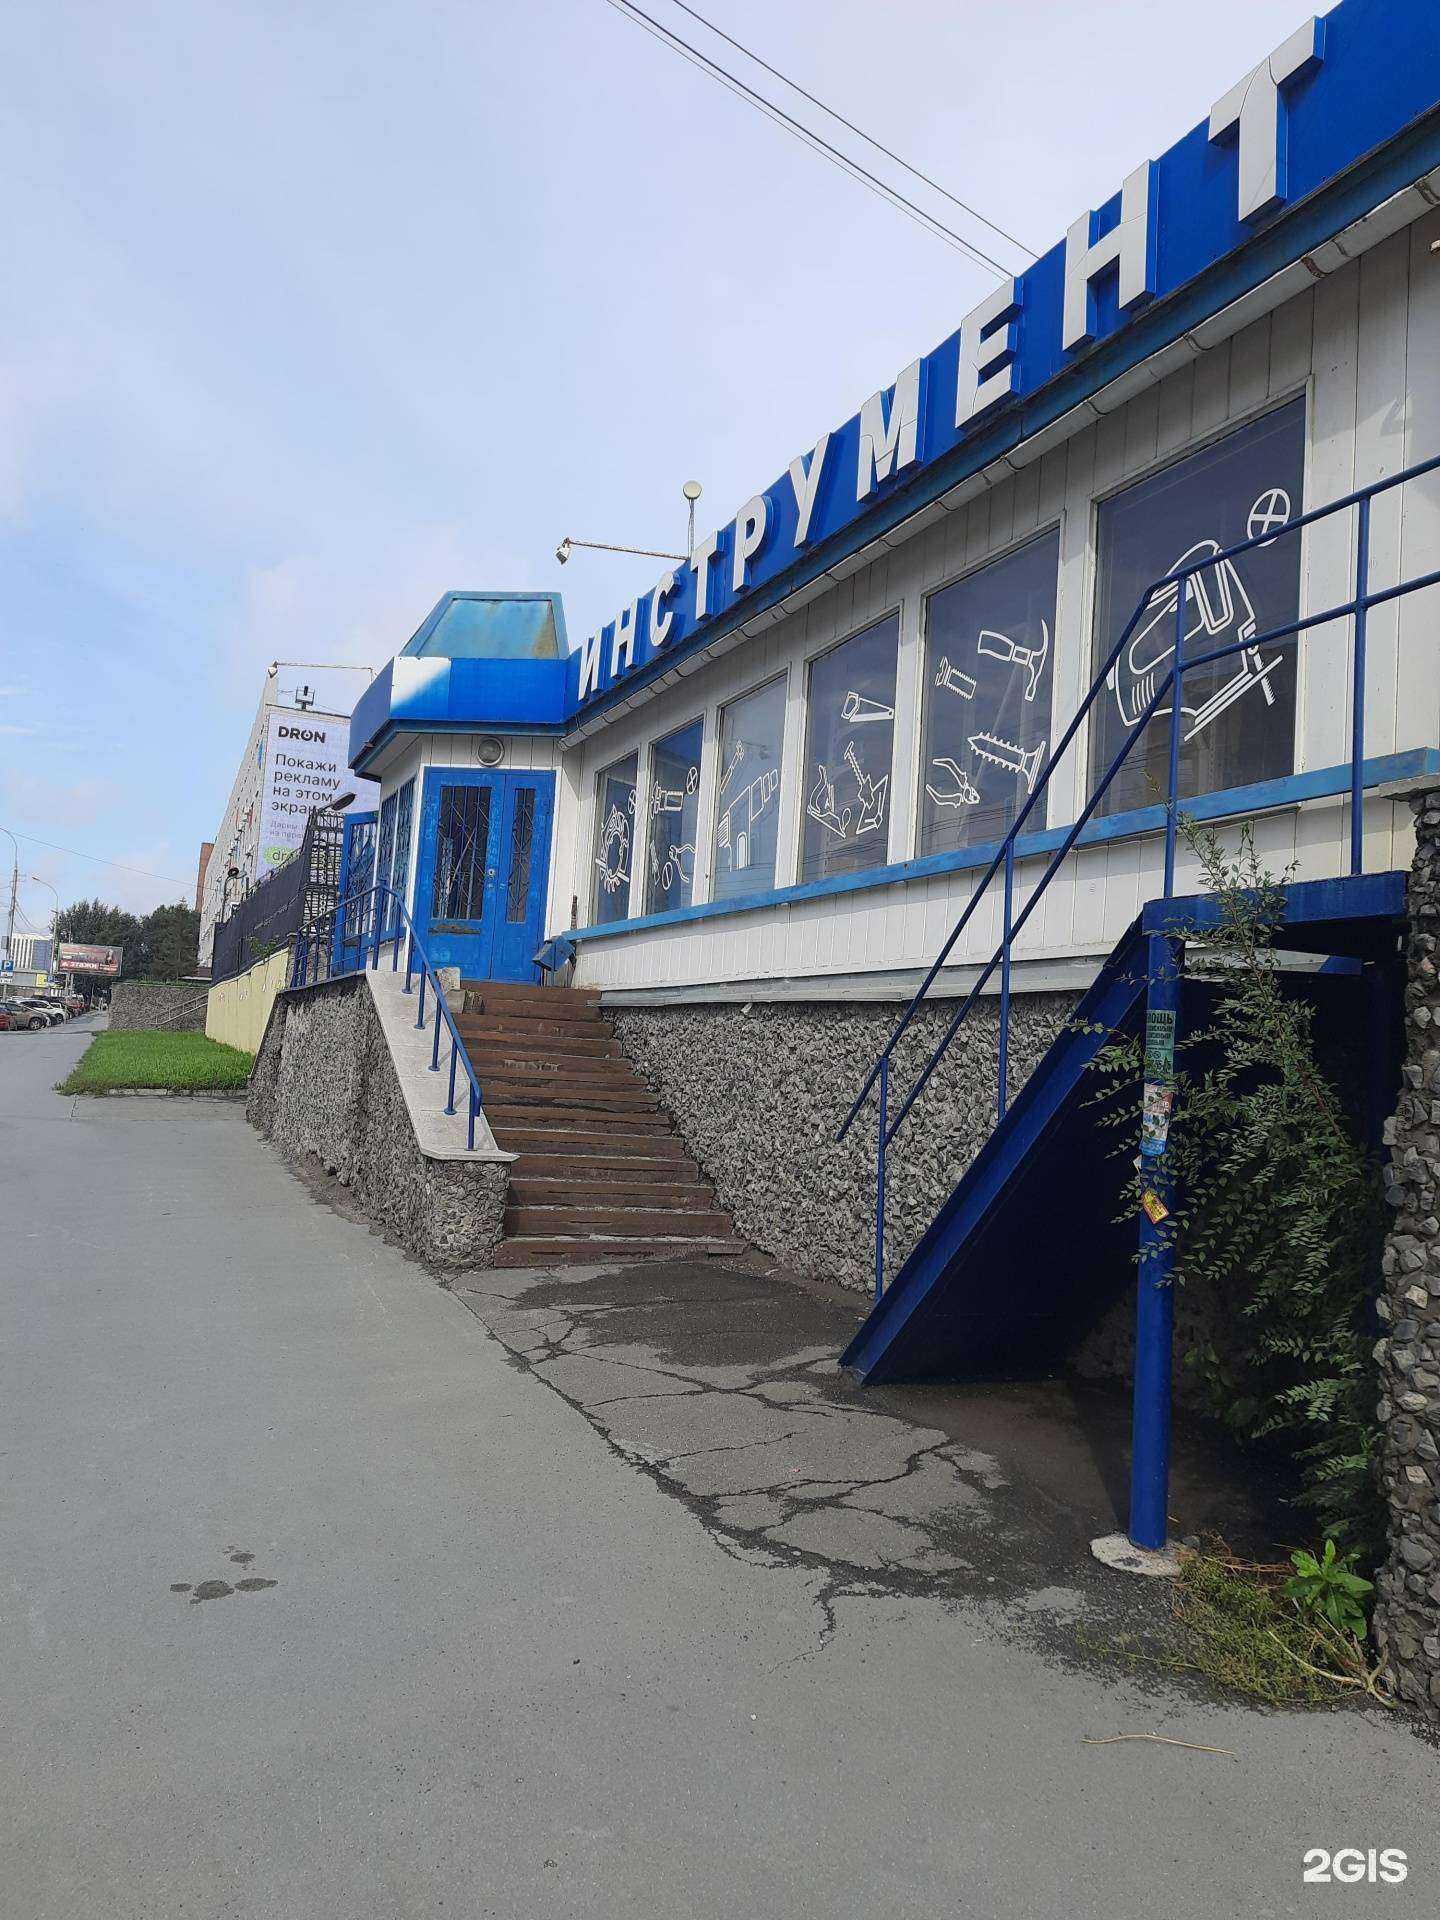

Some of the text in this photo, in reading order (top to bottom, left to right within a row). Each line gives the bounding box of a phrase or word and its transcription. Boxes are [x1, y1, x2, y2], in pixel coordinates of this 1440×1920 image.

[576, 15, 1325, 702] ИНСТРУМЕНТ
[278, 726, 326, 744] DRON
[275, 753, 337, 773] Покажи
[274, 771, 341, 791] рекламу
[273, 786, 333, 802] на этом
[271, 801, 319, 815] экран
